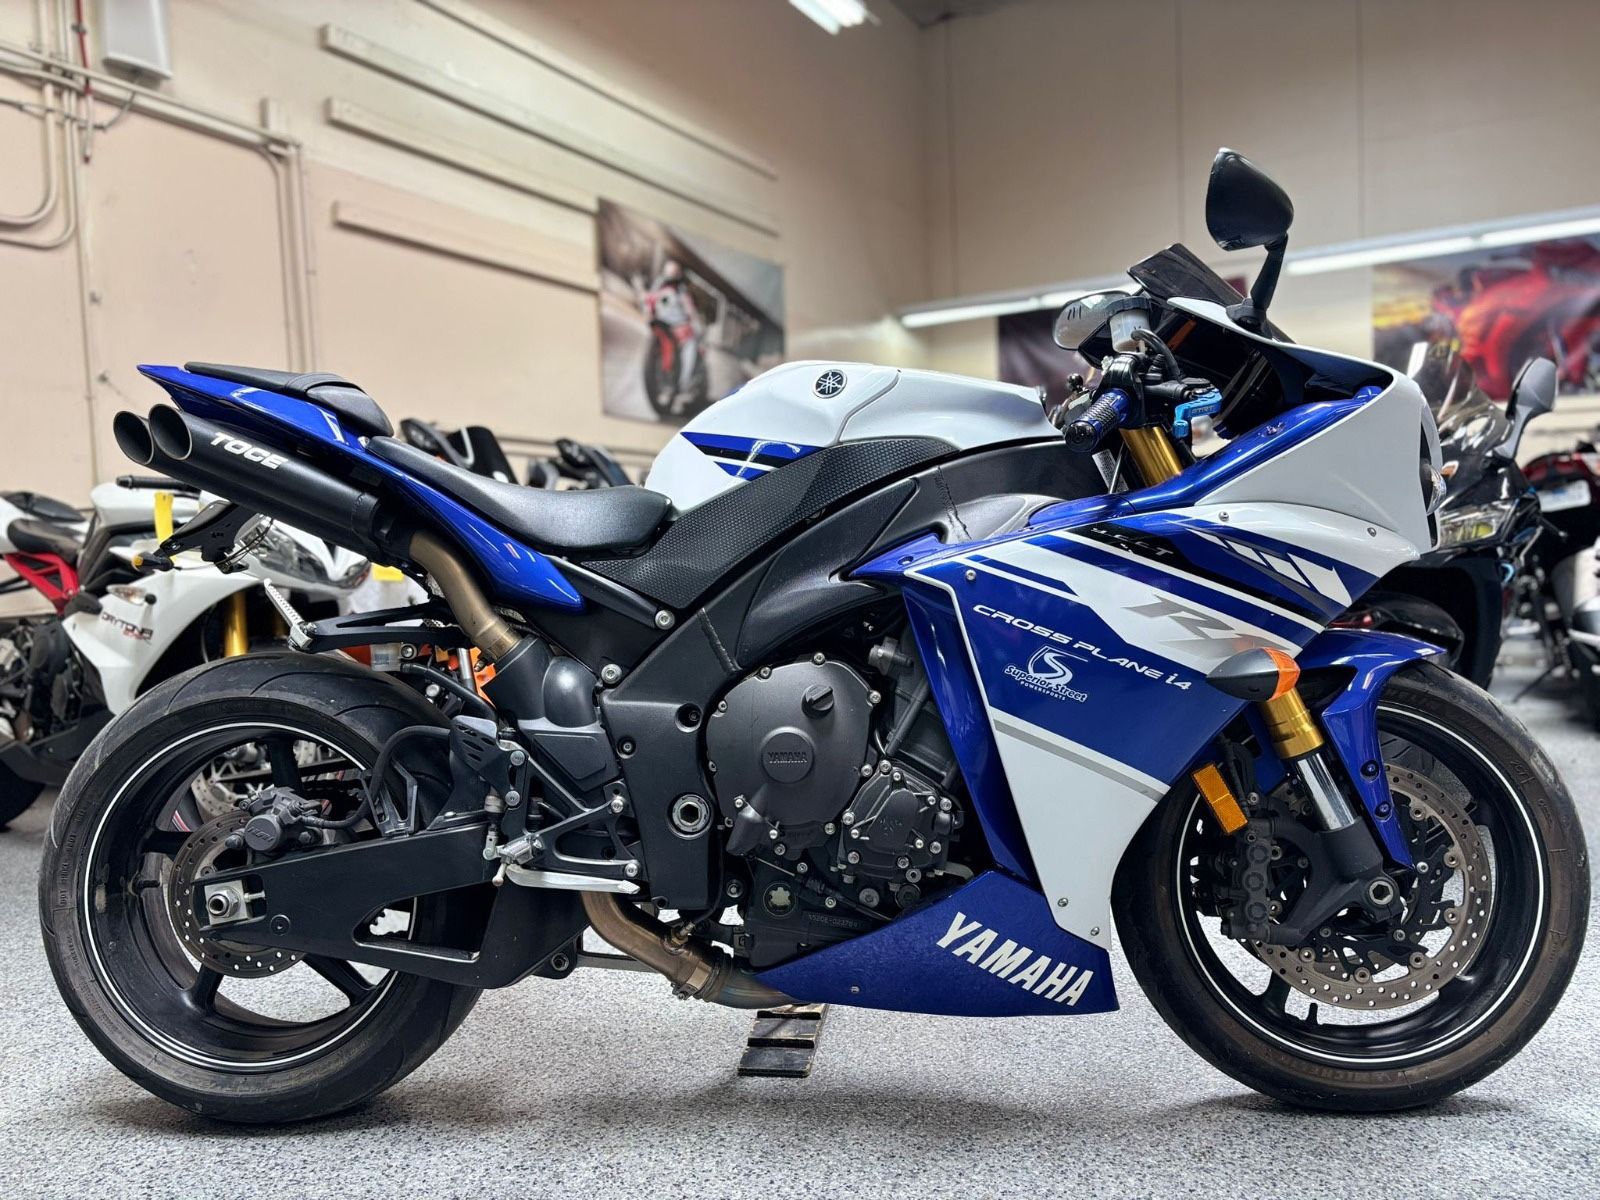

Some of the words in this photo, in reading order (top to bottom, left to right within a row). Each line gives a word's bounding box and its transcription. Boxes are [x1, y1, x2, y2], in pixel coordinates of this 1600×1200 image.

[210, 431, 289, 470] TOCE
[973, 604, 1073, 645] CROSS
[1073, 641, 1164, 681] PLANE
[1004, 665, 1053, 690] Superior
[1051, 683, 1088, 703] Street
[1020, 681, 1066, 701] POWERSPORTS
[767, 751, 808, 764] YAMAHA
[936, 911, 1094, 1007] YAMAHA
